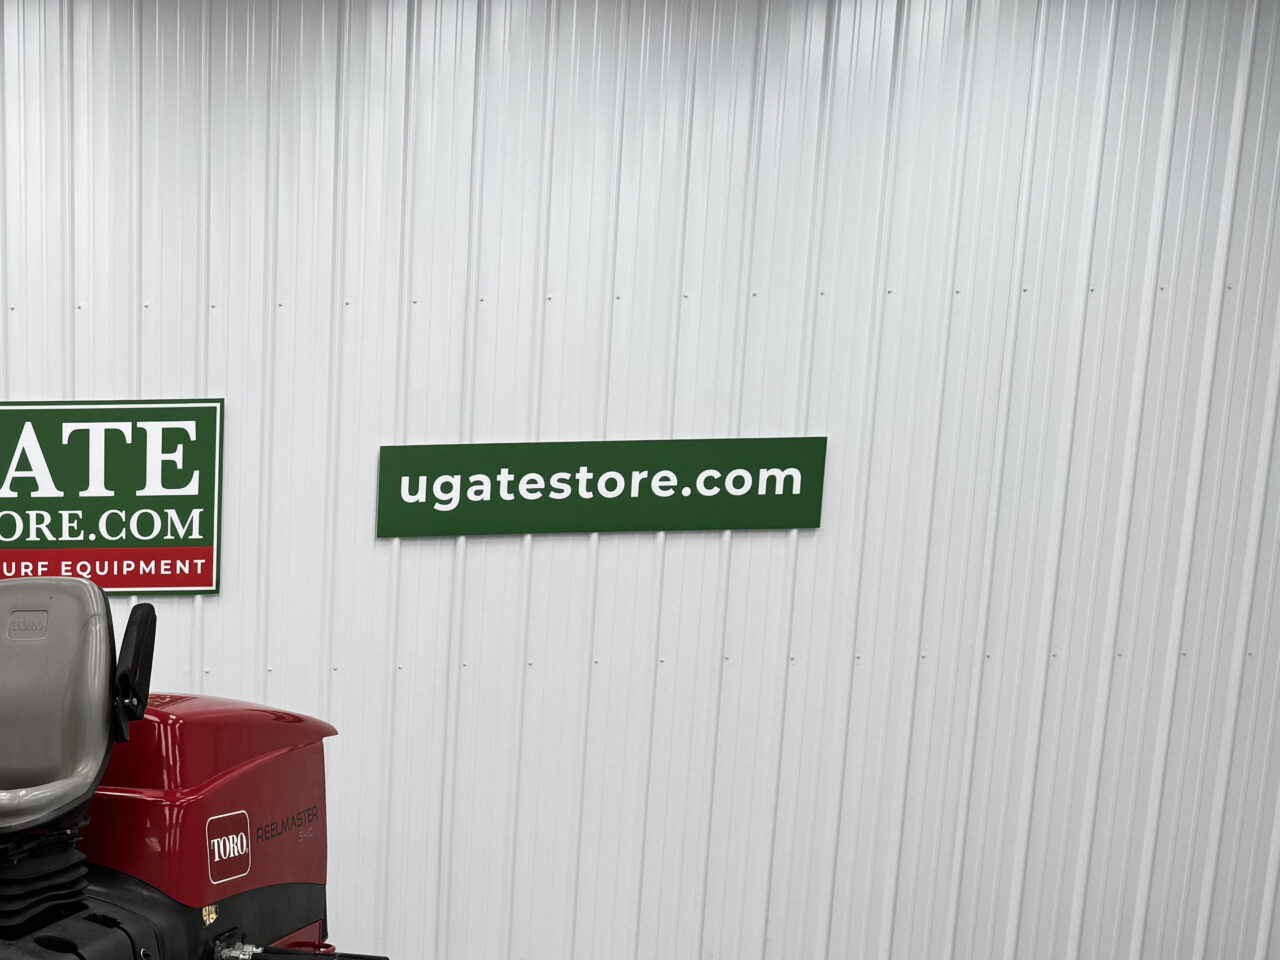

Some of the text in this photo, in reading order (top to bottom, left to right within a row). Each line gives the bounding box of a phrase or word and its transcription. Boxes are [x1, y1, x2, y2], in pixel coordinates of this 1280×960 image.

[400, 466, 803, 512] ugatestore.com
[60, 559, 206, 578] EQUIPMENT
[256, 805, 320, 844] REELMASTER
[210, 831, 248, 863] TORO
